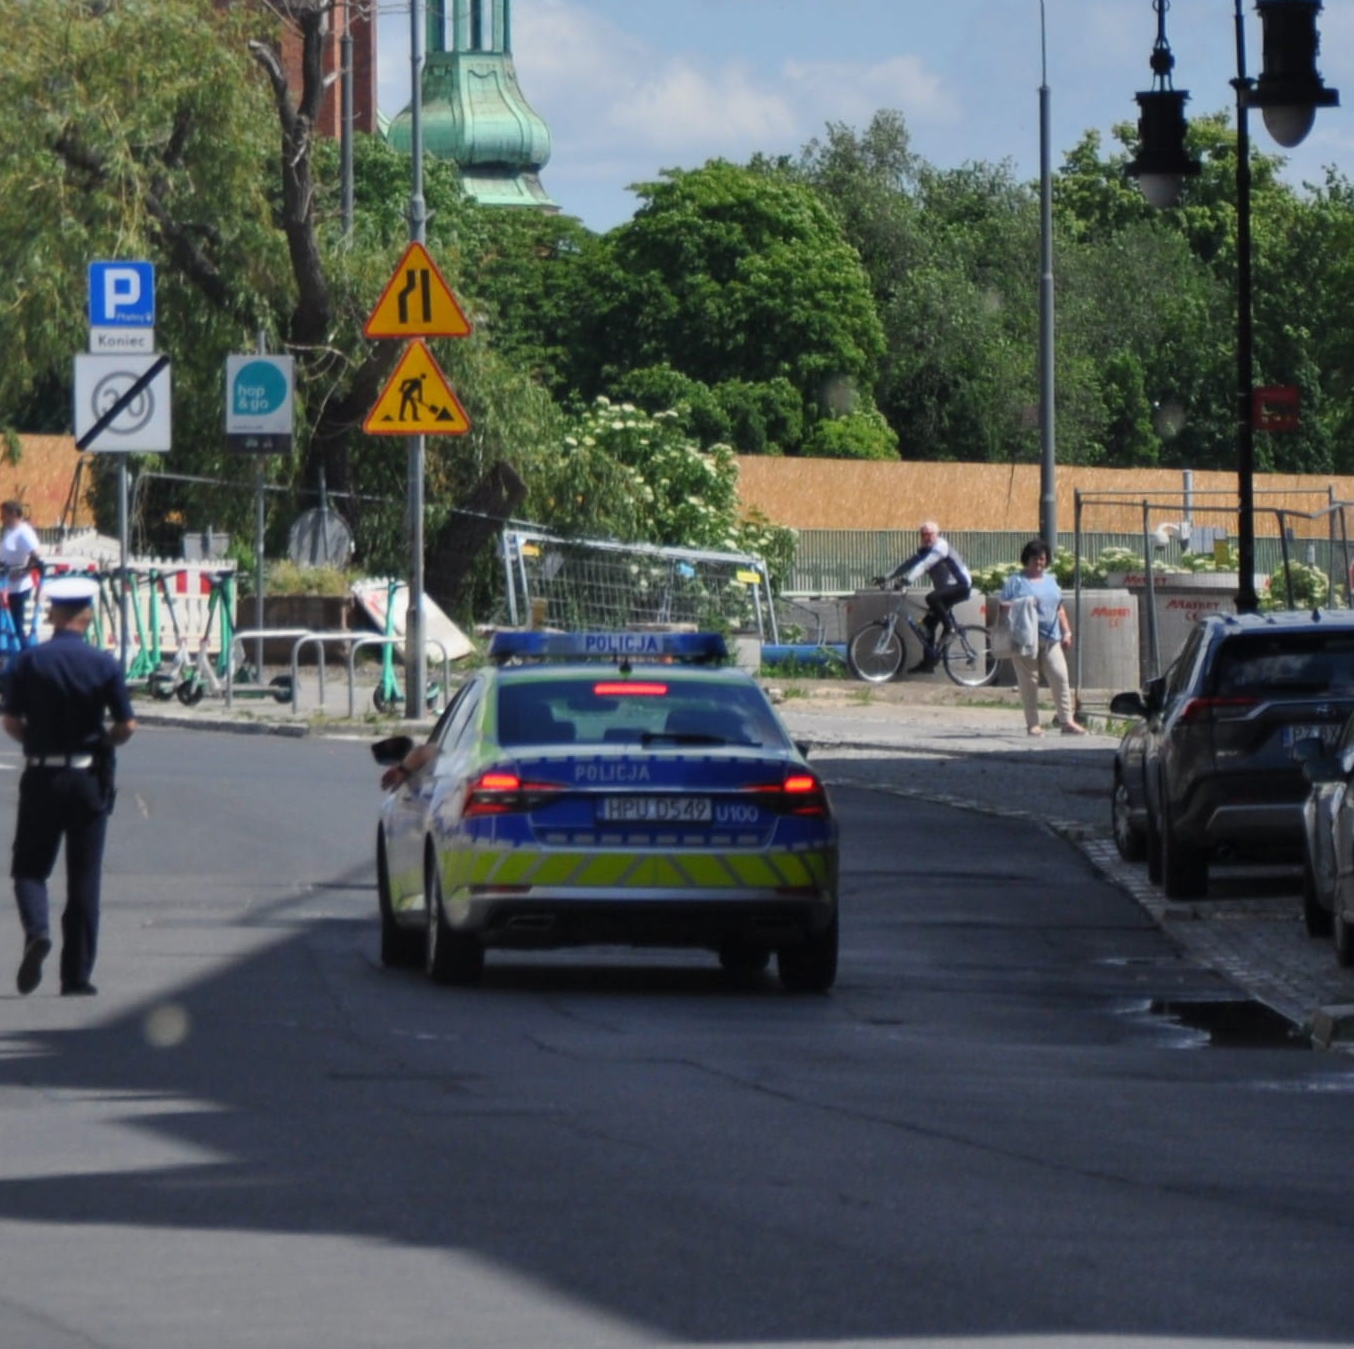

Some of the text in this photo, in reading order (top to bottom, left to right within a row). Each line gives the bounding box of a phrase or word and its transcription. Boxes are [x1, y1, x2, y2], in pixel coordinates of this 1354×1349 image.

[104, 268, 141, 319] P
[98, 334, 144, 347] Koniec
[237, 384, 265, 399] hop
[585, 635, 658, 652] POLICJA
[575, 764, 650, 781] POLICJA
[716, 804, 759, 822] U100
